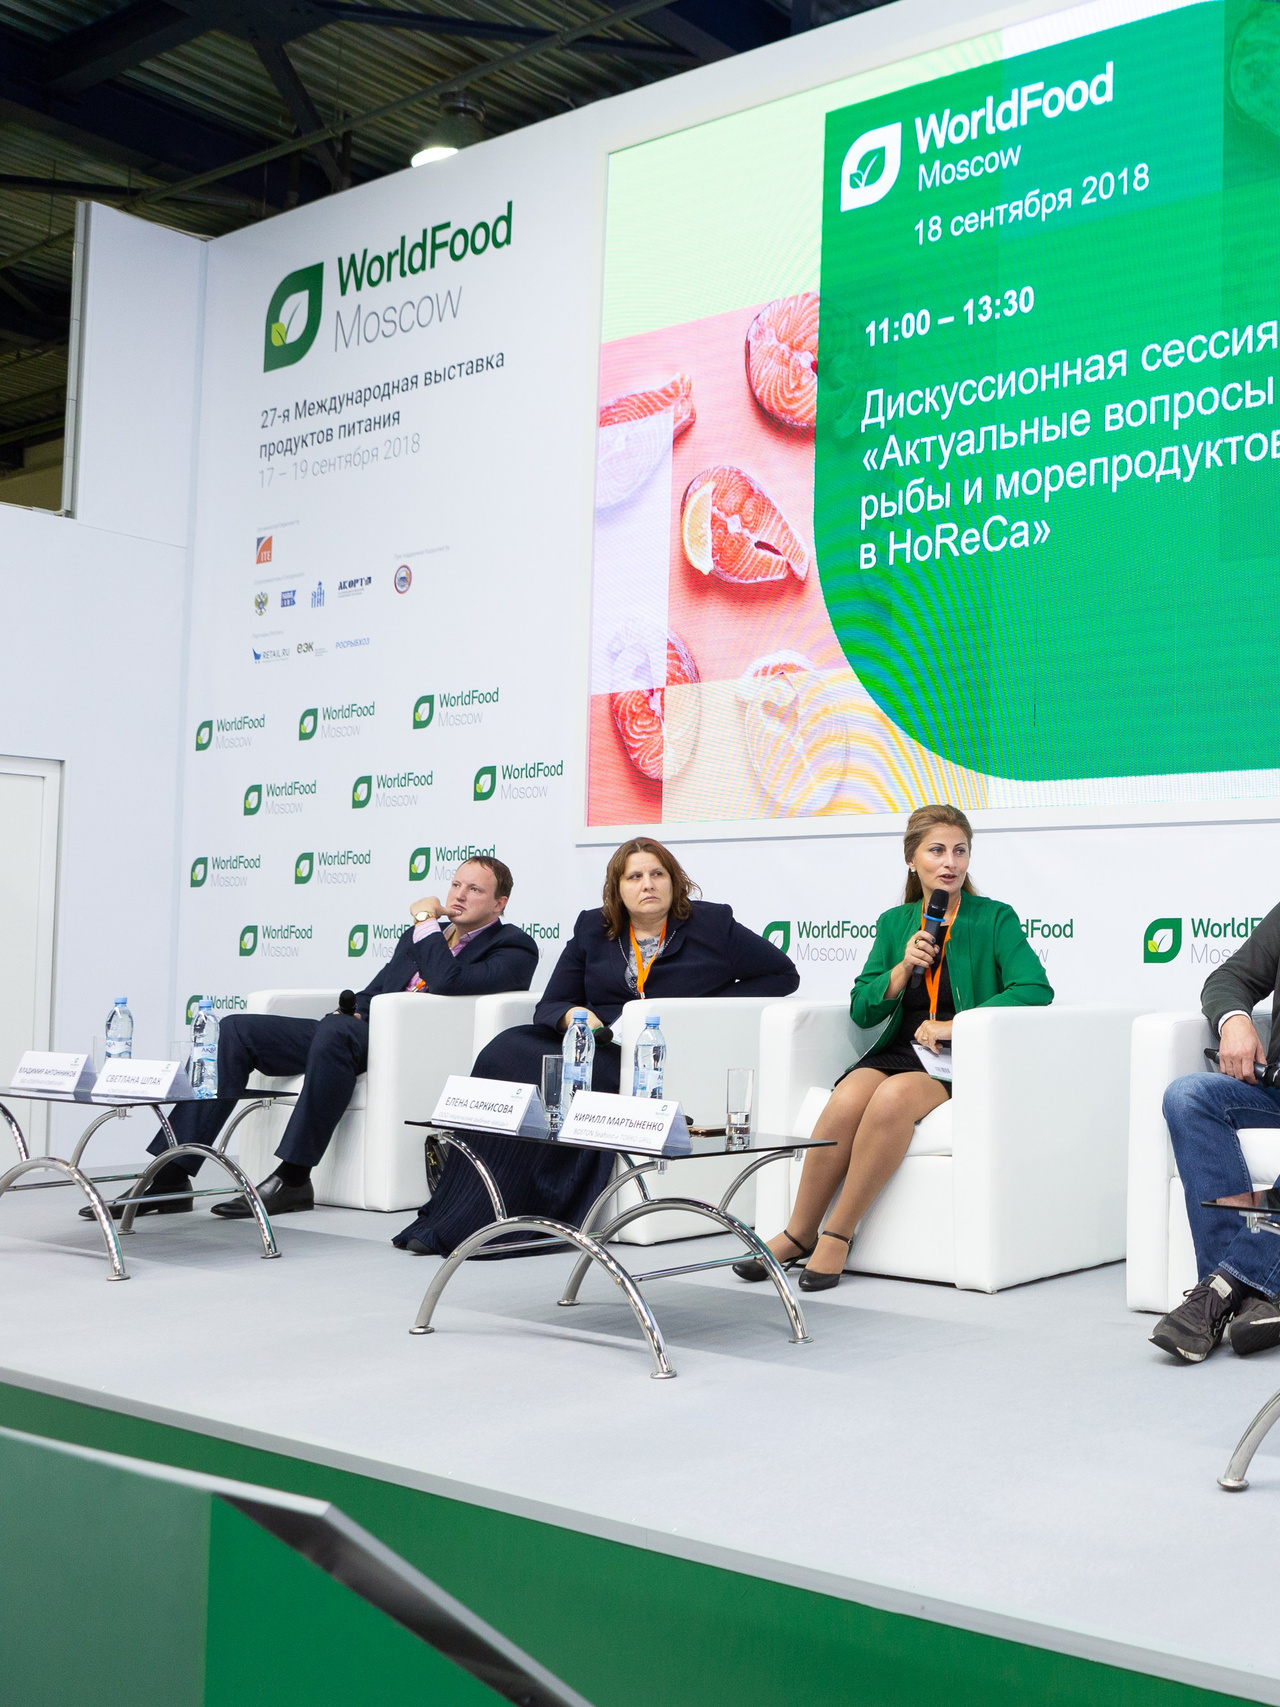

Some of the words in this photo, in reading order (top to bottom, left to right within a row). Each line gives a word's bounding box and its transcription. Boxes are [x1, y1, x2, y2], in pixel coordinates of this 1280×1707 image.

[914, 60, 1114, 154] WorldFood
[918, 145, 1022, 191] Moscow
[914, 215, 942, 245] 18
[950, 187, 1072, 237] сентября
[1081, 163, 1150, 206] 2018
[337, 200, 513, 297] WorldFood
[334, 286, 463, 352] Moscow
[864, 309, 931, 347] 11:00
[962, 285, 1035, 326] 13:30
[861, 349, 1128, 432] Дискуссионная
[1141, 320, 1278, 373] сессия
[260, 408, 290, 430] 27-я
[294, 373, 419, 422] Международная
[424, 351, 505, 388] выставка
[862, 407, 1091, 472] «Актуальные
[1104, 374, 1273, 433] вопросы
[259, 427, 334, 462] продуктов
[338, 410, 401, 442] питания
[259, 468, 275, 488] 17
[293, 461, 308, 481] 19
[311, 445, 379, 479] сентября
[383, 433, 421, 461] 2018
[860, 480, 951, 529] рыбы
[963, 474, 983, 505] и
[858, 540, 877, 570] в
[888, 514, 1052, 566] HoReCa»
[439, 687, 499, 709] WorldFood
[322, 701, 375, 721] WorldFood
[438, 711, 484, 728] Moscow
[216, 714, 265, 733] WorldFood
[321, 723, 361, 740] Moscow
[215, 735, 252, 751] Moscow
[376, 770, 434, 789] WorldFood
[501, 760, 564, 781] WorldFood
[265, 780, 317, 798] WorldFood
[500, 783, 549, 801] Moscow
[264, 799, 304, 816] Moscow
[375, 791, 419, 809] Moscow
[211, 855, 261, 871] WorldFood
[318, 850, 371, 867] WorldFood
[210, 872, 248, 888] Moscow
[317, 867, 357, 884] Moscow
[261, 924, 313, 941] WorldFood
[1019, 918, 1074, 939] dFood
[260, 941, 301, 958] Moscow
[371, 943, 395, 959] Mos
[796, 943, 858, 962] Moscow
[1190, 943, 1239, 965] Mos
[106, 1075, 139, 1085] СВЕТЛАНА
[140, 1077, 163, 1086] ШПАК
[445, 1097, 469, 1109] ЕЛЕНА
[469, 1100, 514, 1115] САРКИСОВА
[573, 1112, 606, 1125] КИРИЛЛ
[607, 1116, 665, 1132] МАРТЫНЕНКО
